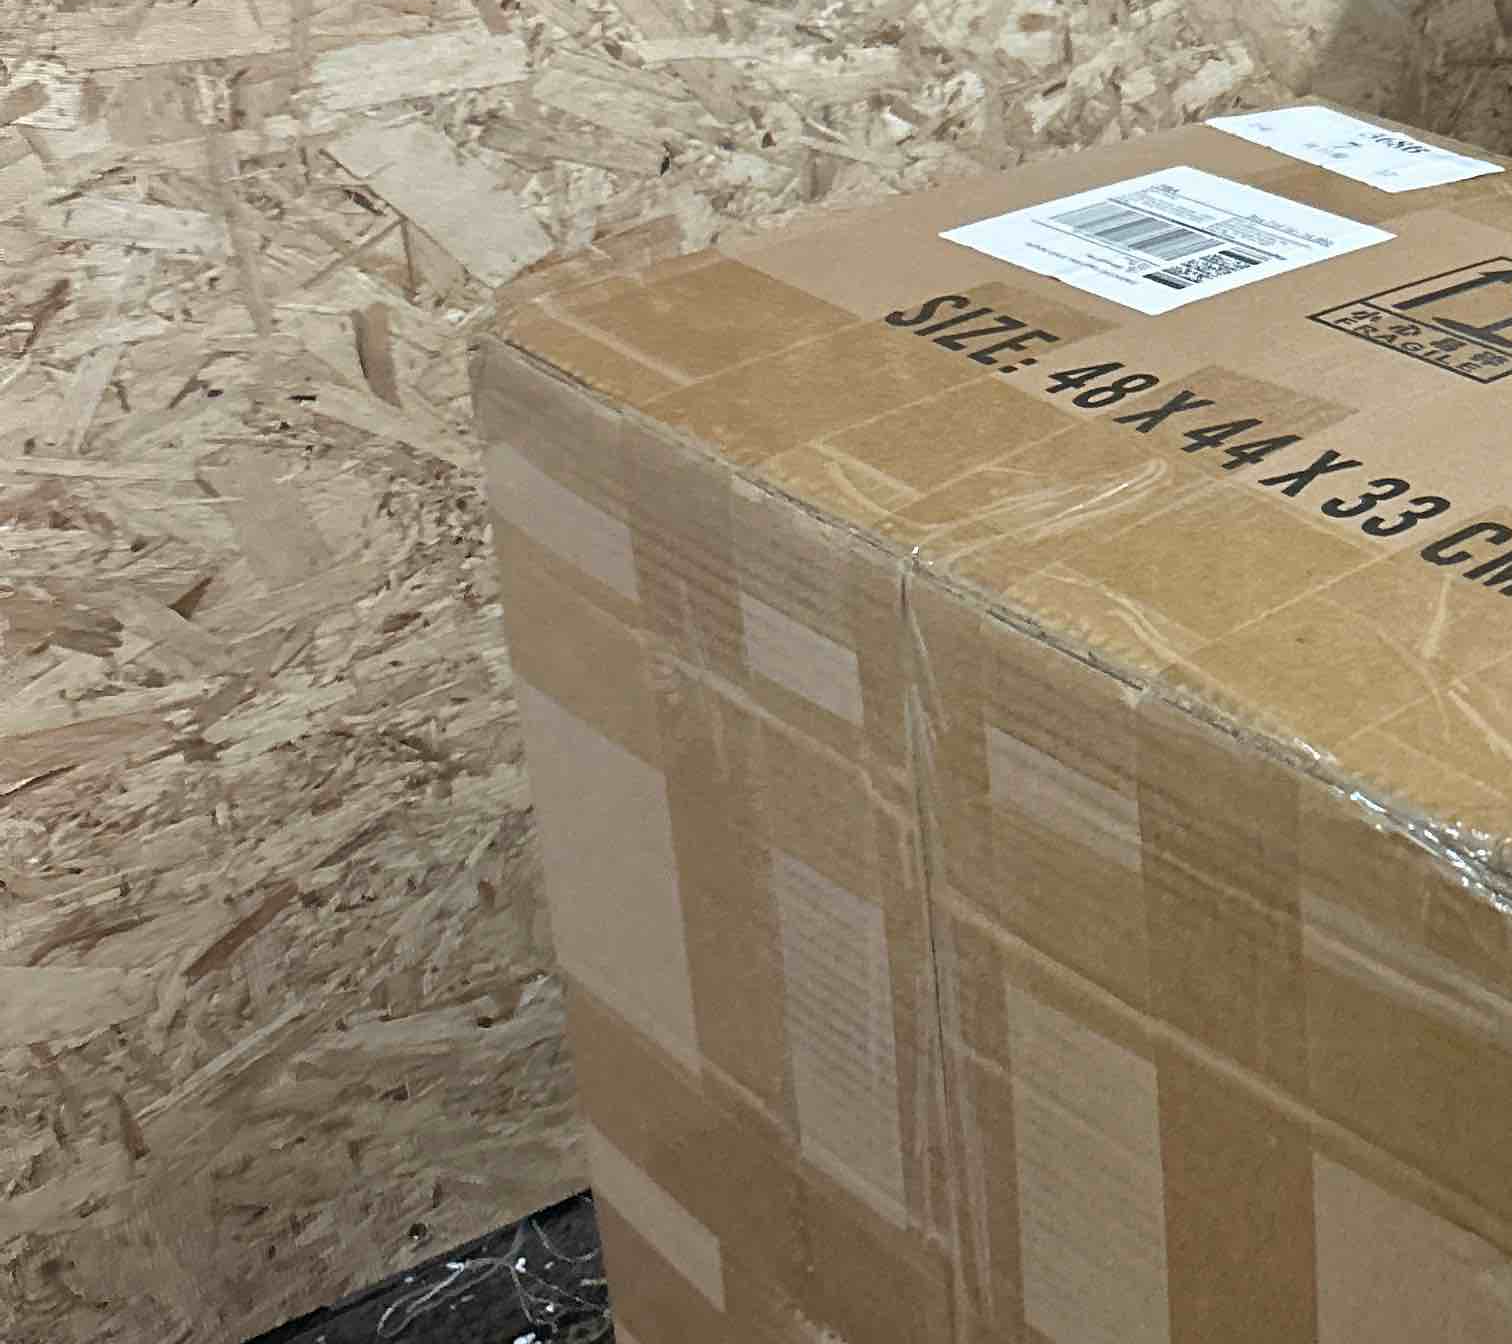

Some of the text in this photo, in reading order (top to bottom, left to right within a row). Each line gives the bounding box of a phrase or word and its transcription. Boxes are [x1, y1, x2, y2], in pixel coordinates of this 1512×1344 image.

[885, 295, 1060, 373] SIZE:
[1046, 362, 1160, 409] 48
[1113, 390, 1215, 433] X
[1181, 418, 1303, 470] 44
[1258, 449, 1363, 497] X
[1321, 478, 1451, 537] 33
[1334, 317, 1483, 374] FRAGILE
